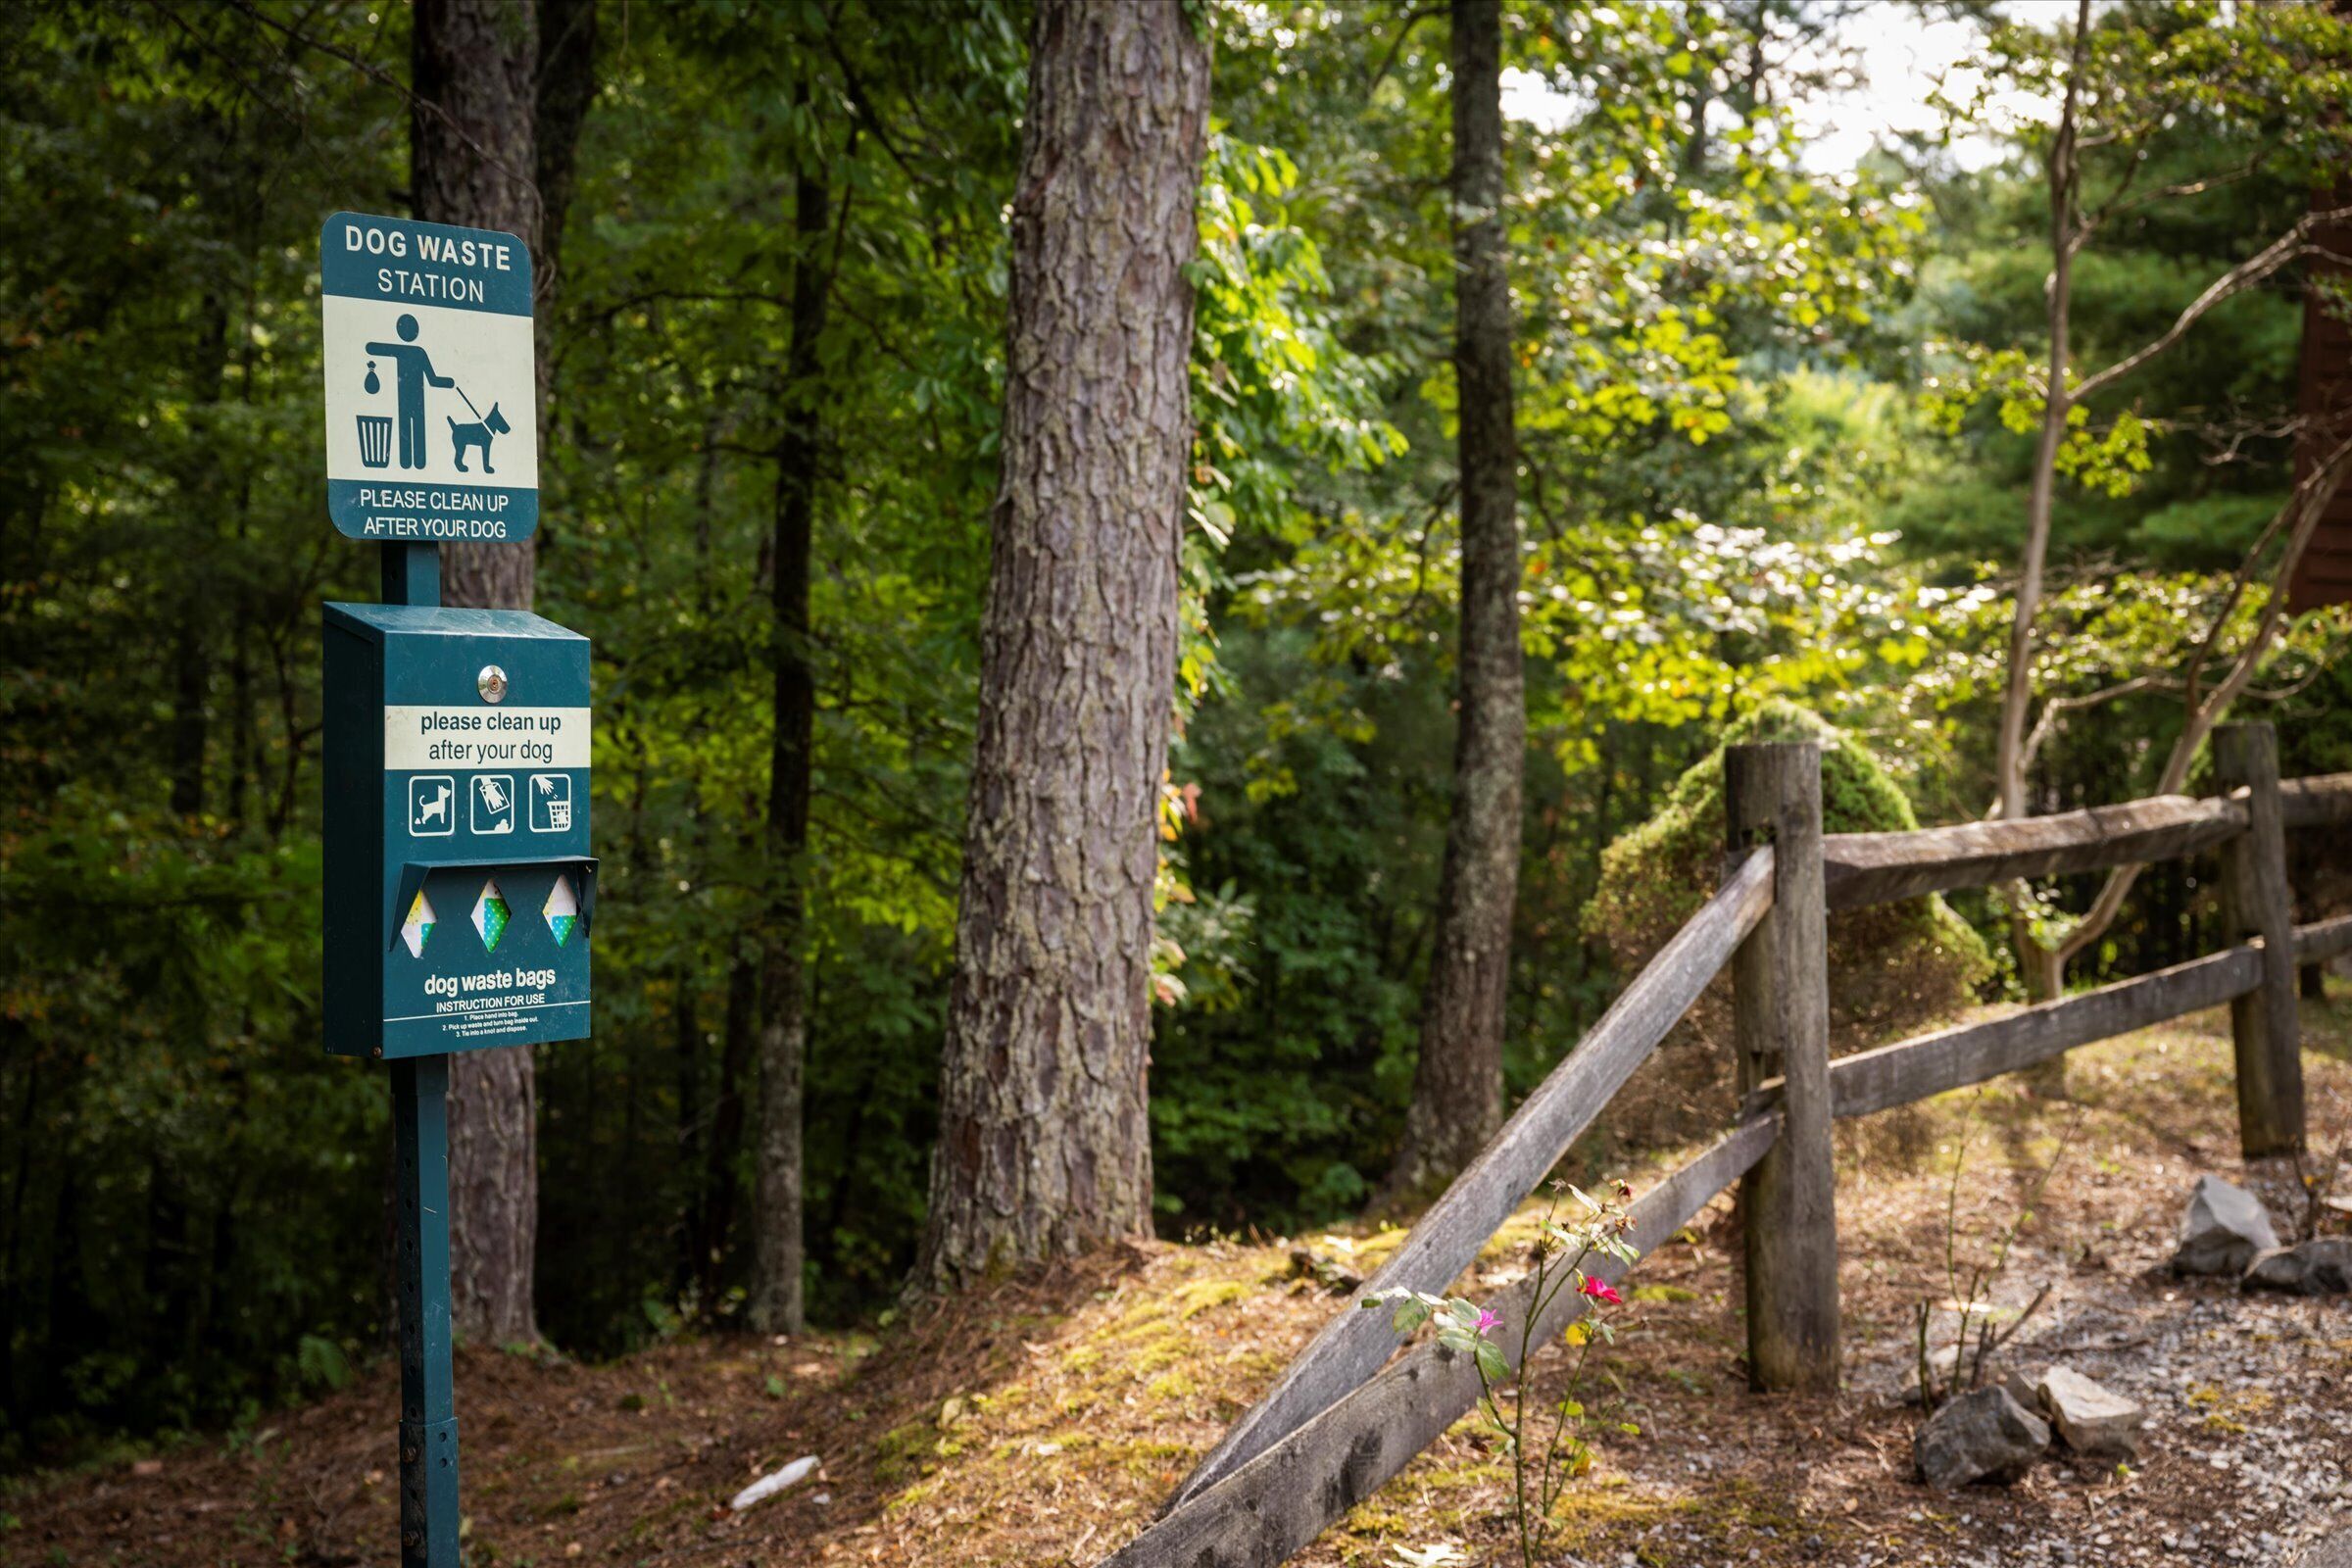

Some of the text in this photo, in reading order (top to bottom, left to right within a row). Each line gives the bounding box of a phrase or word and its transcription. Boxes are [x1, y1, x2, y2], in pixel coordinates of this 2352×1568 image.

[345, 225, 511, 271] DOG WASTE
[378, 268, 484, 304] STATION
[360, 489, 509, 513] PLEASE CLEAN UP
[364, 516, 507, 538] AFTER YOUR DOG
[420, 711, 562, 735] please clean up
[429, 739, 553, 764] after your dog
[424, 968, 556, 998] dog waste bags
[436, 993, 545, 1013] INSTRUCTION FOR USE
